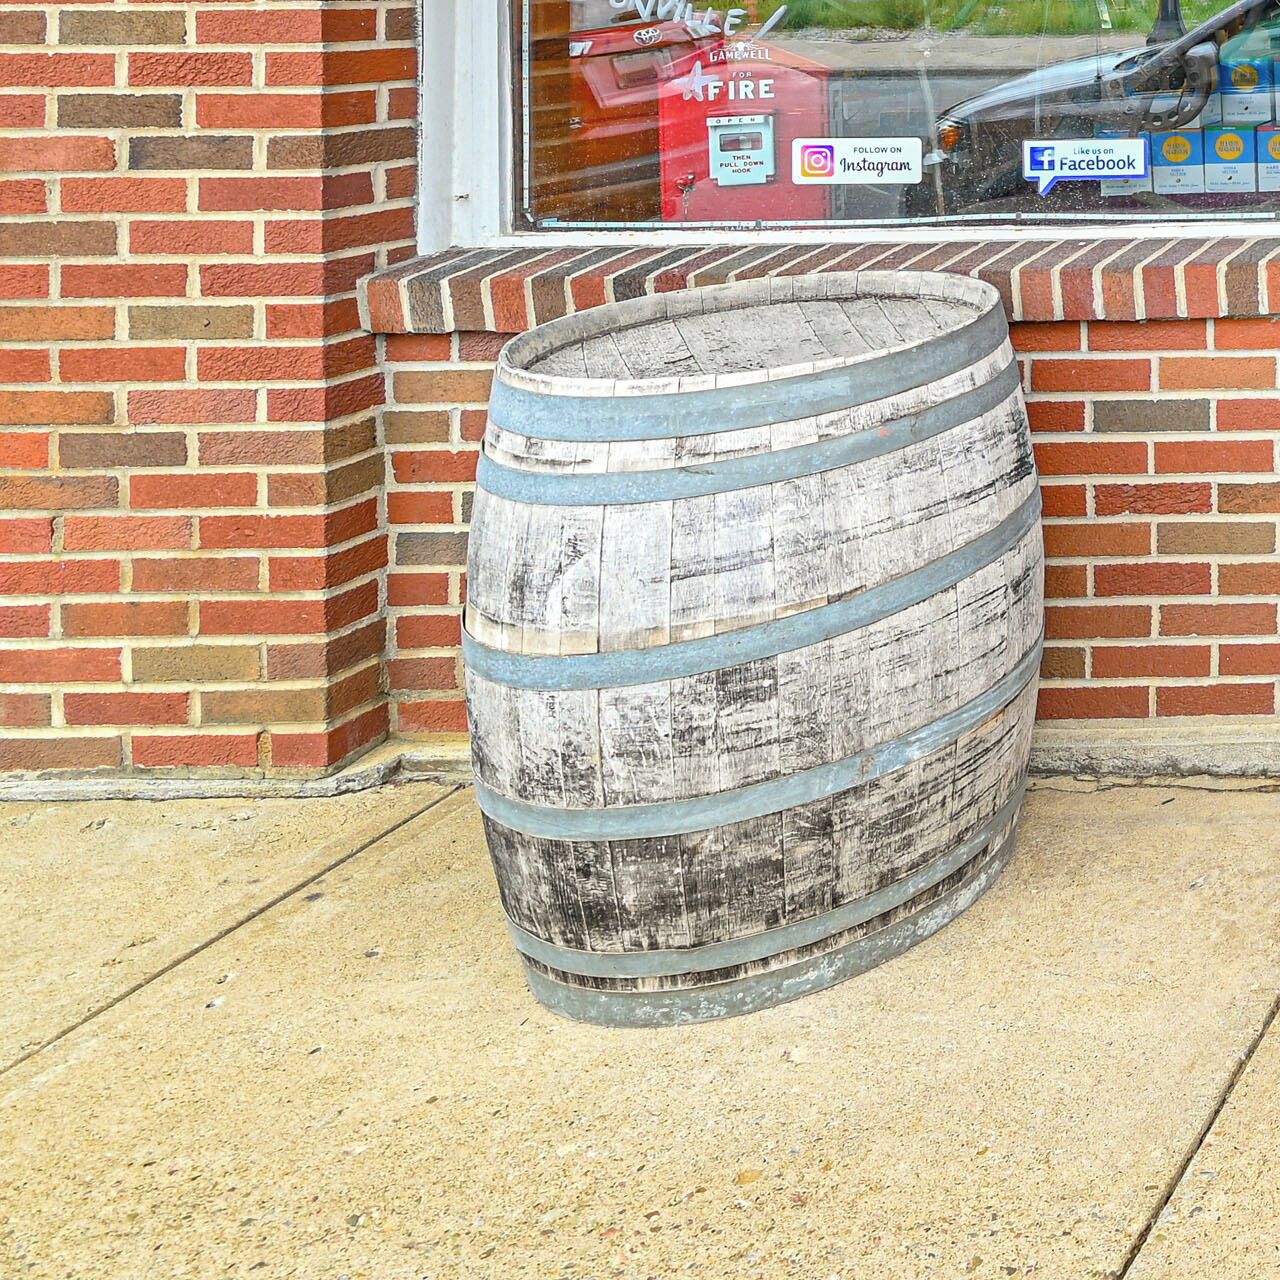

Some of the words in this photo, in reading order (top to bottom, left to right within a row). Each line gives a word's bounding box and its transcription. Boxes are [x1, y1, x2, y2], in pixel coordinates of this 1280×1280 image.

[709, 50, 772, 62] GAMEWELL
[707, 80, 775, 101] FIRE
[1073, 147, 1090, 155] Like
[839, 157, 912, 178] Instagram
[1060, 155, 1136, 171] Facebook
